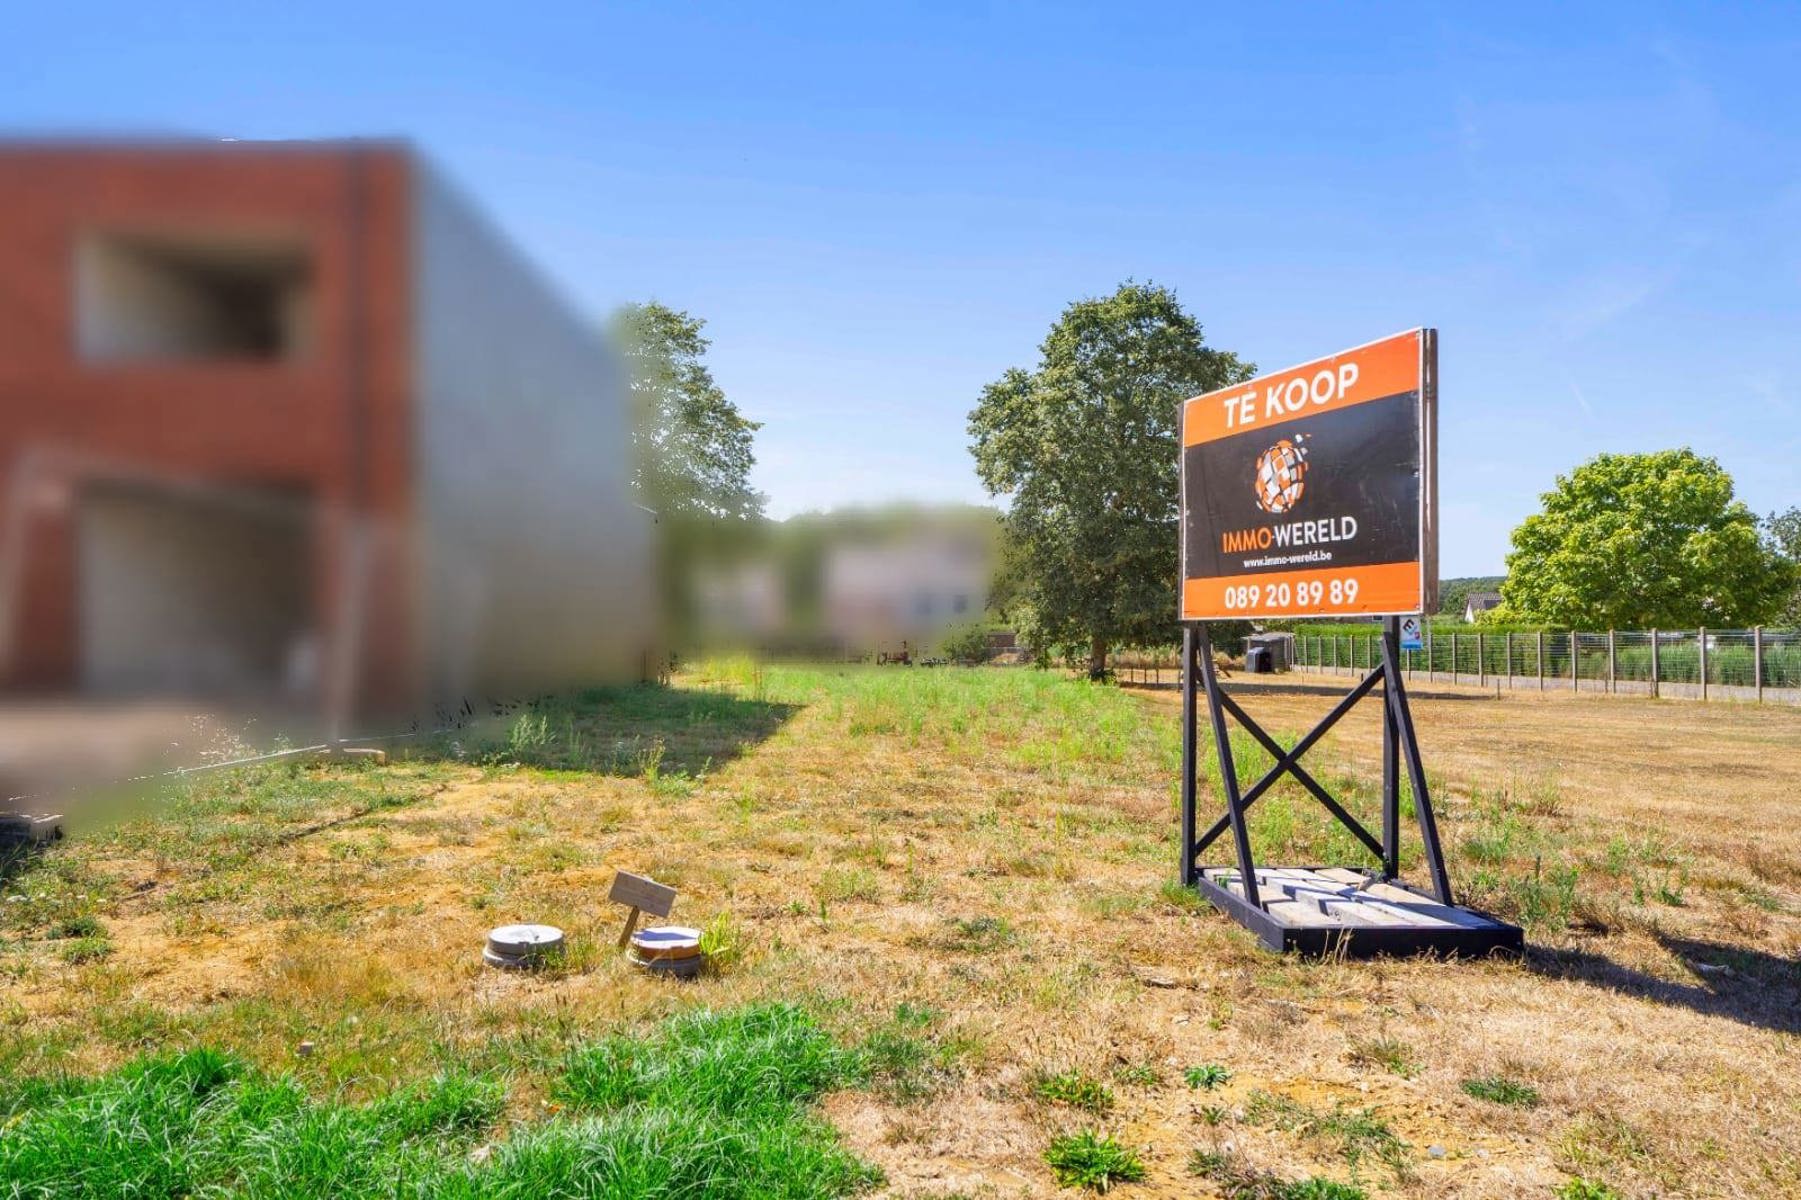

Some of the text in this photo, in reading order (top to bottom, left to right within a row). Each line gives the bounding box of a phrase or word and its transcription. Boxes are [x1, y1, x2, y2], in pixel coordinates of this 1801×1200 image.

[1224, 362, 1359, 428] TE KOOP
[1243, 550, 1332, 568] www.immo-wereld.be
[1225, 578, 1359, 609] 089 20 89 89
